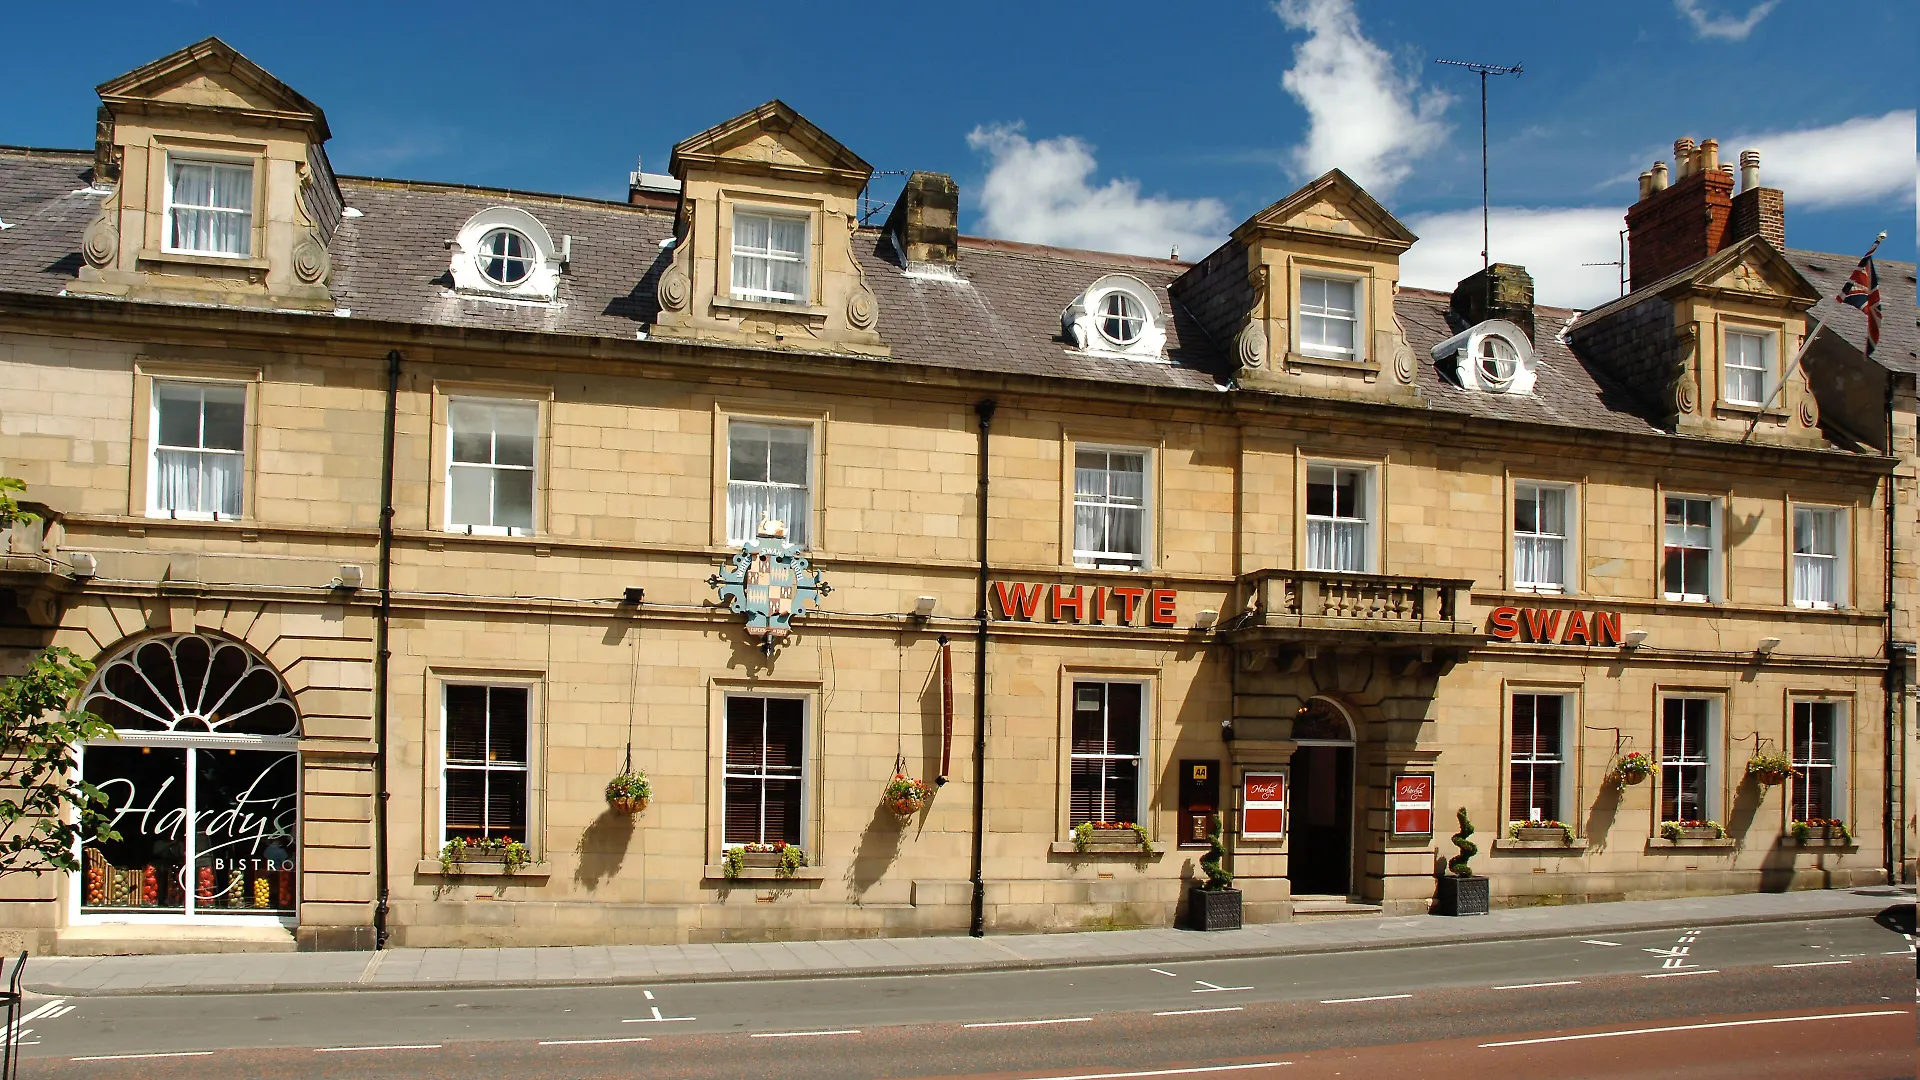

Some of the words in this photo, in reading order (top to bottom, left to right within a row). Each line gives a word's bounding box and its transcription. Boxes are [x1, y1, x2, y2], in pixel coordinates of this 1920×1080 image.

[761, 547, 783, 556] SWAN
[790, 560, 804, 581] HOTEL
[995, 581, 1177, 624] WHITE
[1493, 607, 1622, 643] SWAN
[1195, 768, 1206, 776] AA
[80, 753, 297, 899] Hardy's
[215, 858, 294, 871] BISTRO
